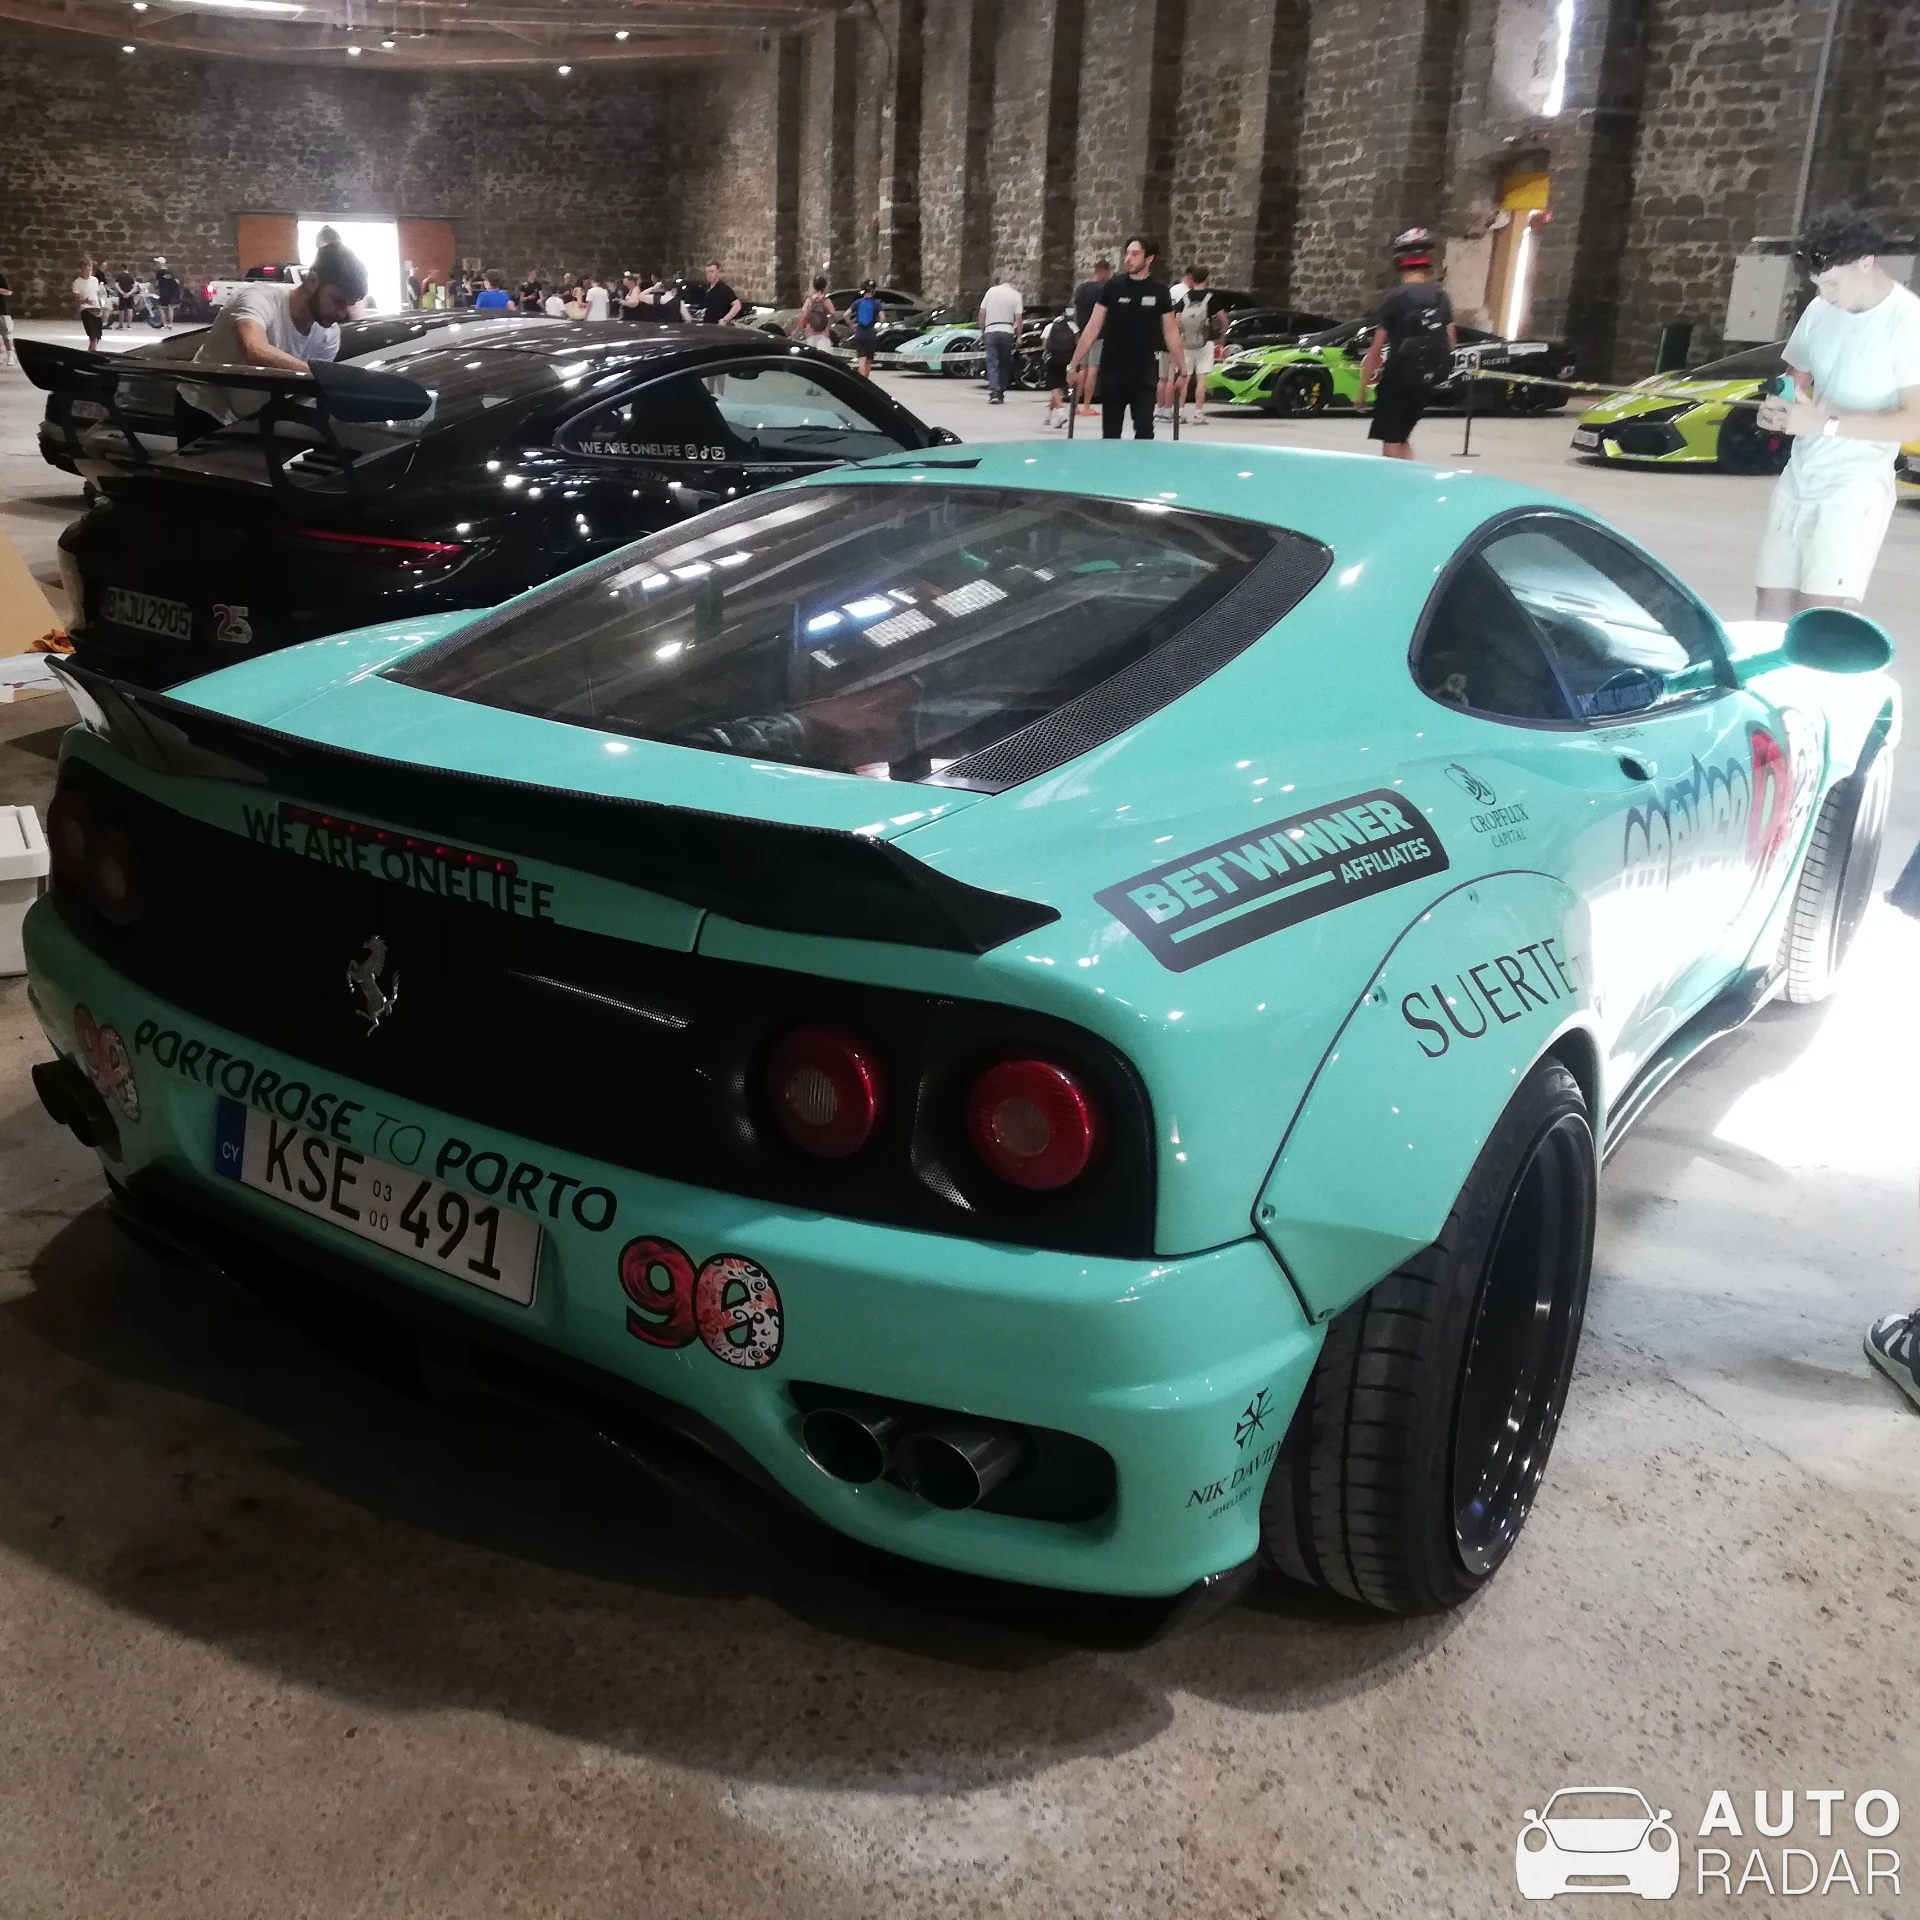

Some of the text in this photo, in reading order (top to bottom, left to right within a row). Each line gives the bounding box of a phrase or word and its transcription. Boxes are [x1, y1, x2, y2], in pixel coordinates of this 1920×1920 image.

[578, 441, 682, 457] WE ARE ONELIFE
[212, 603, 253, 644] 25
[1469, 803, 1530, 834] CROPFLUX
[1490, 828, 1528, 848] CAPITAL
[242, 803, 556, 924] WE ARE ONELIFE
[1125, 799, 1414, 925] BETWINNER
[1339, 837, 1432, 884] AFFILIATES
[1401, 937, 1579, 1058] SUERTE
[134, 1019, 618, 1232] PORTOROSE TO PORTO
[221, 1141, 240, 1163] CY
[265, 1119, 501, 1281] KSE 03 491
[369, 1210, 389, 1231] 00
[1184, 1475, 1230, 1509] NIK
